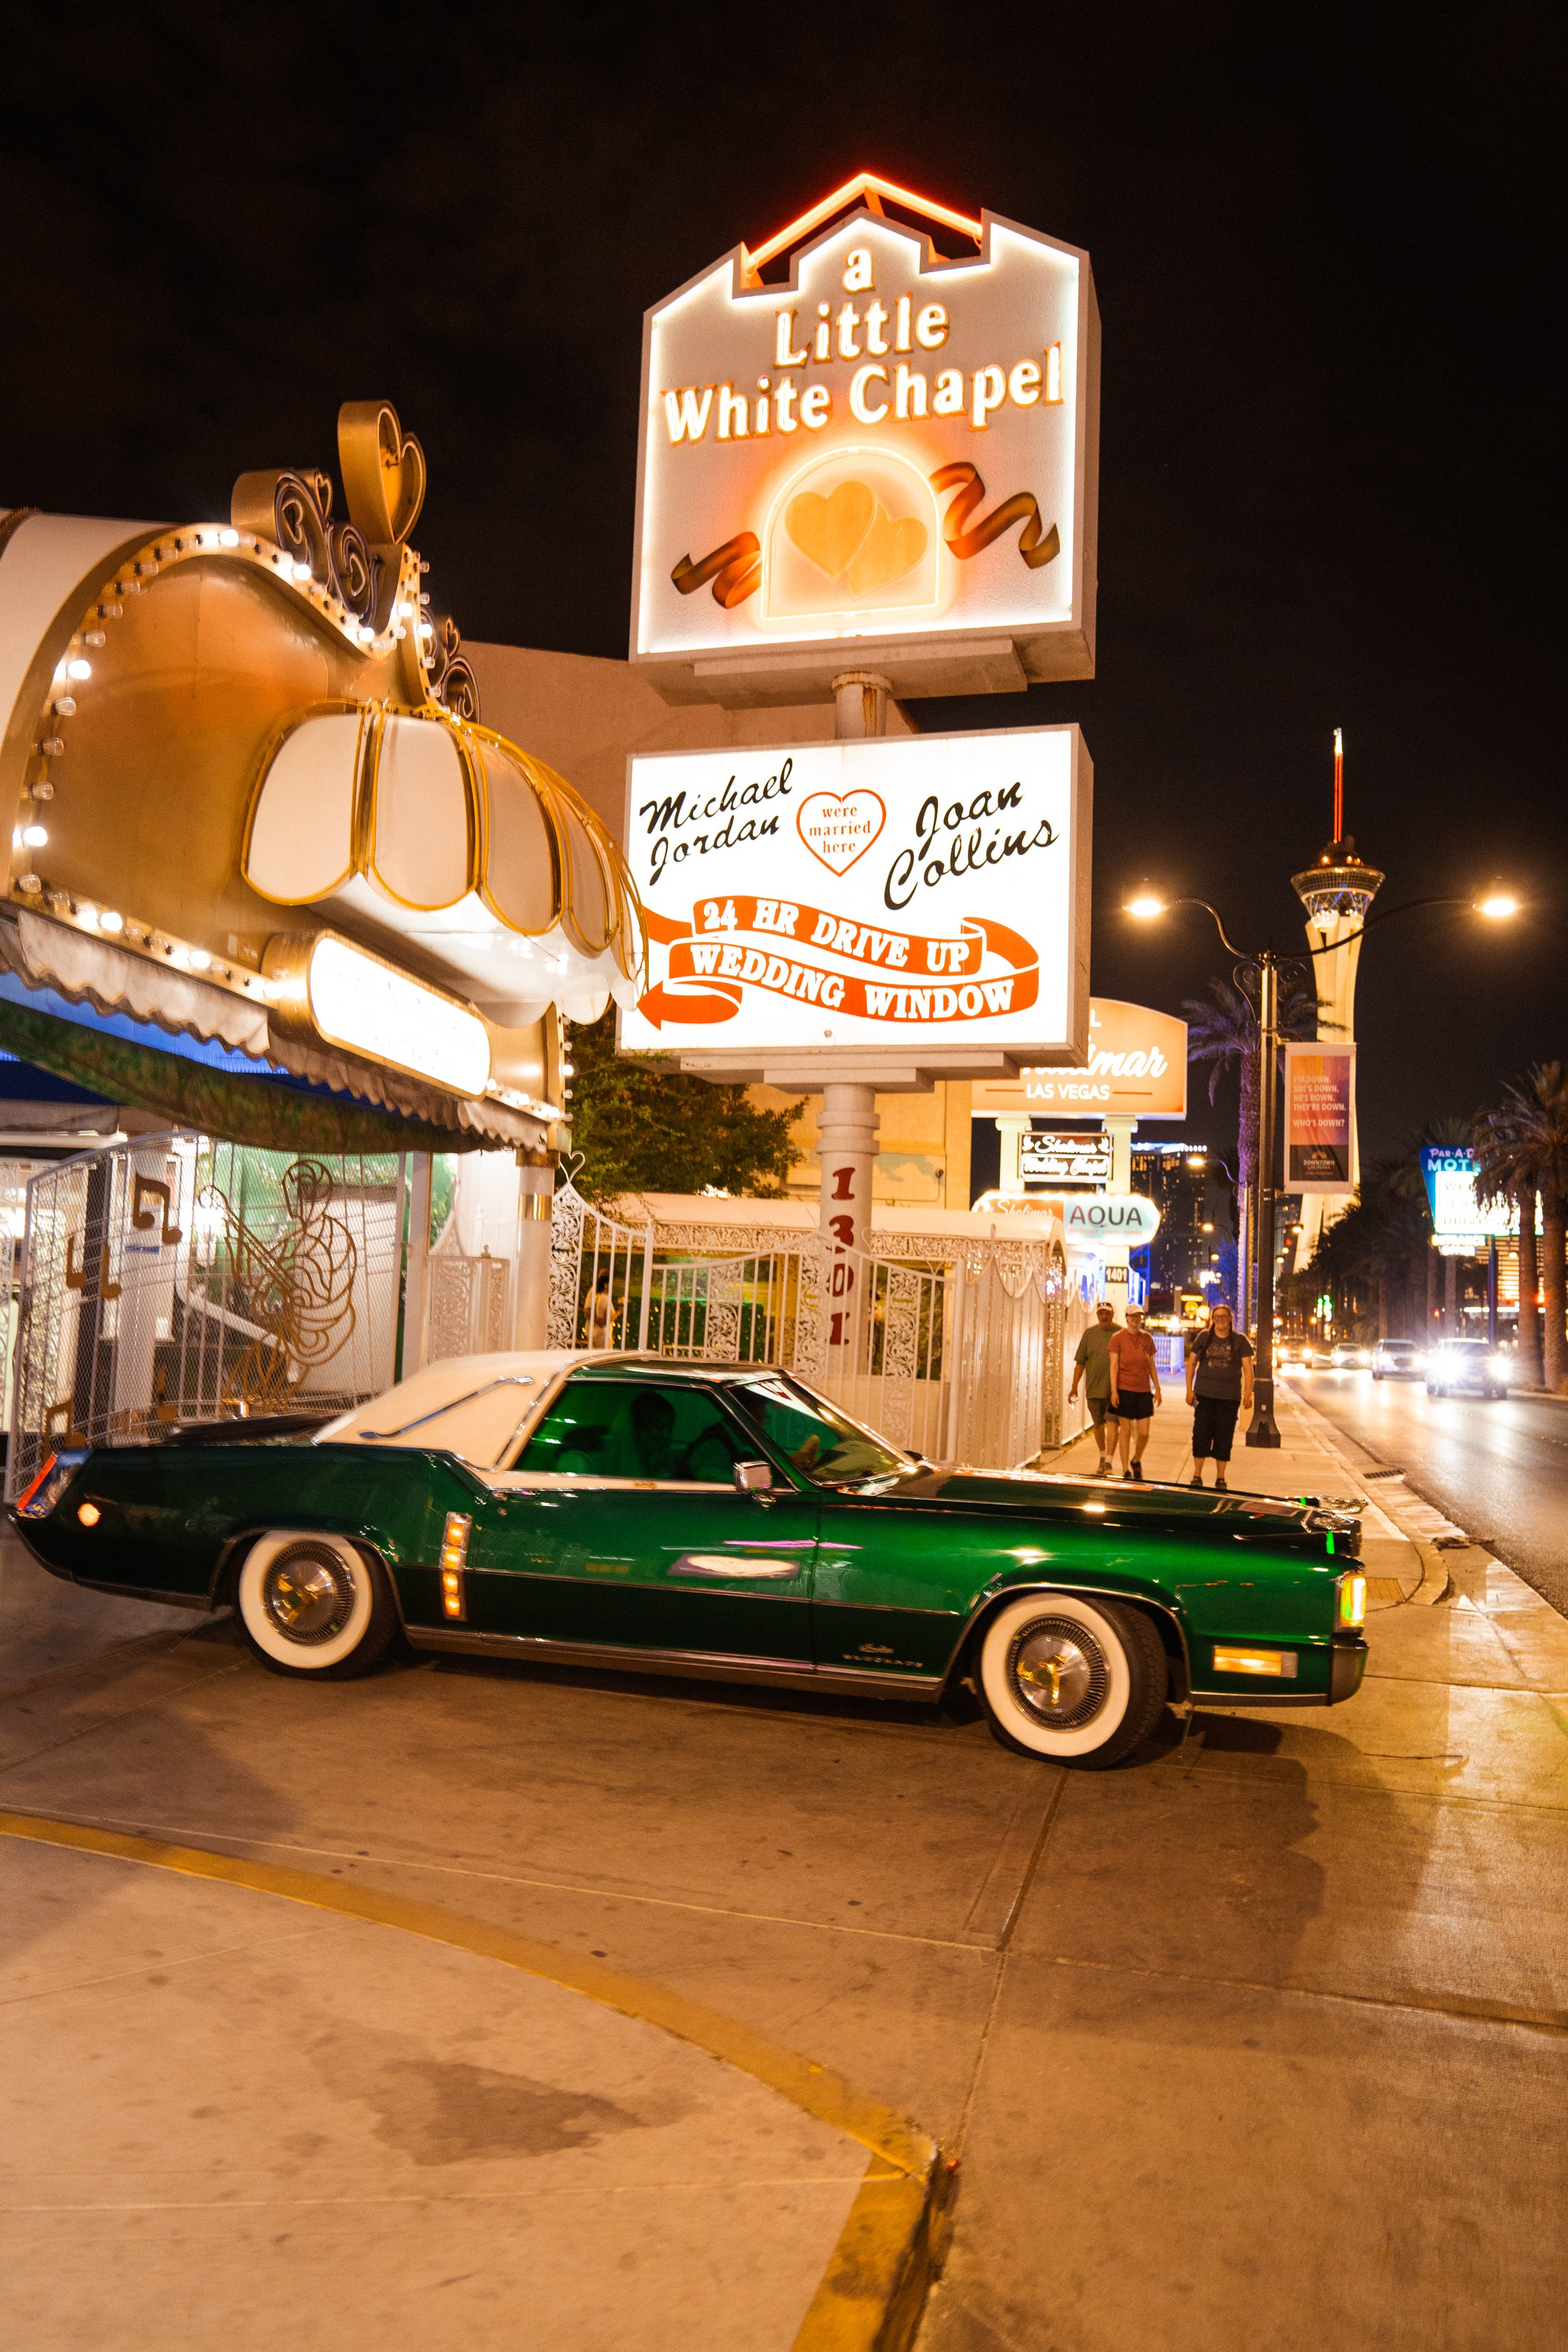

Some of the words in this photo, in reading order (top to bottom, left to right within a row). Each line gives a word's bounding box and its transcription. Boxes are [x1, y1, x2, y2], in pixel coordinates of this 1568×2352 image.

[842, 247, 874, 292] a
[773, 292, 949, 369] Little
[661, 375, 831, 446] White
[849, 341, 1065, 432] Chapel
[639, 758, 793, 835] Michael
[822, 806, 857, 817] were
[916, 782, 1024, 855] Joan
[649, 812, 780, 885] Jordan
[810, 820, 871, 836] married
[822, 840, 856, 853] here
[884, 819, 1060, 910] Collins
[703, 901, 738, 932] 24
[753, 899, 800, 935] HR
[810, 916, 909, 968] DRIVE
[927, 940, 970, 973] UP
[690, 944, 846, 1009] WEDDING
[865, 979, 1015, 1019] WINDOW
[1026, 1083, 1055, 1099] LAS
[1058, 1083, 1110, 1100] VEGAS
[1314, 1085, 1339, 1093] DOWN.
[1070, 1205, 1143, 1227] AQUA
[1107, 1267, 1128, 1282] 1401
